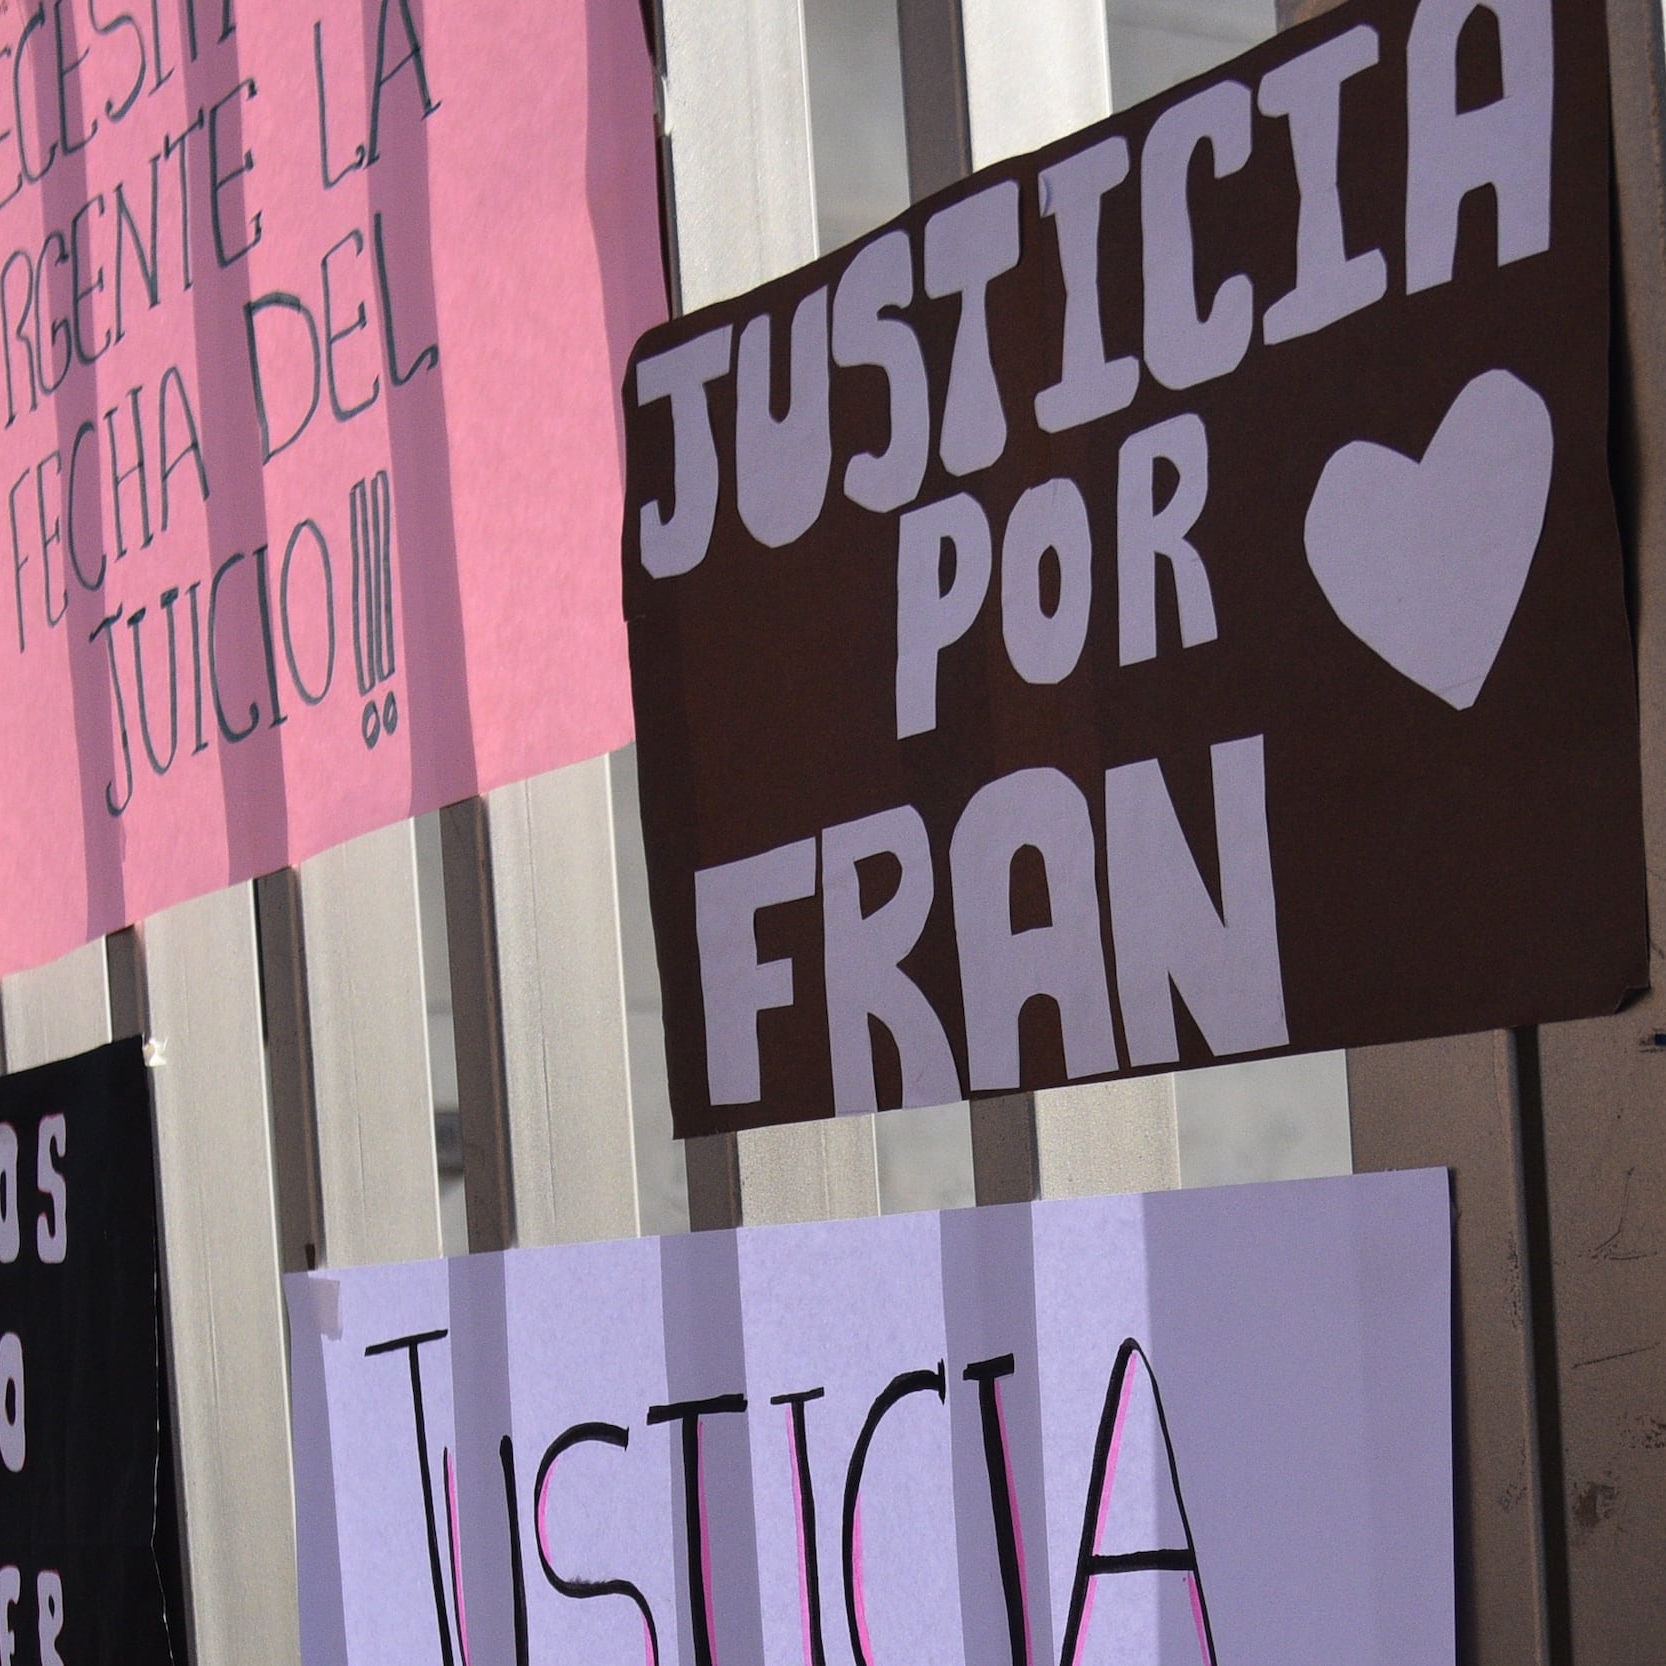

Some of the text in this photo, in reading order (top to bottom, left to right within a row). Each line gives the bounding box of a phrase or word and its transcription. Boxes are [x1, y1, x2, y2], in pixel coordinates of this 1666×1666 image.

[313, 0, 441, 190] LA
[9, 212, 439, 653] FECHA DEL
[635, 0, 1555, 579] JUSTICIA
[895, 412, 1220, 740] POR
[694, 733, 1290, 1115] FRAN
